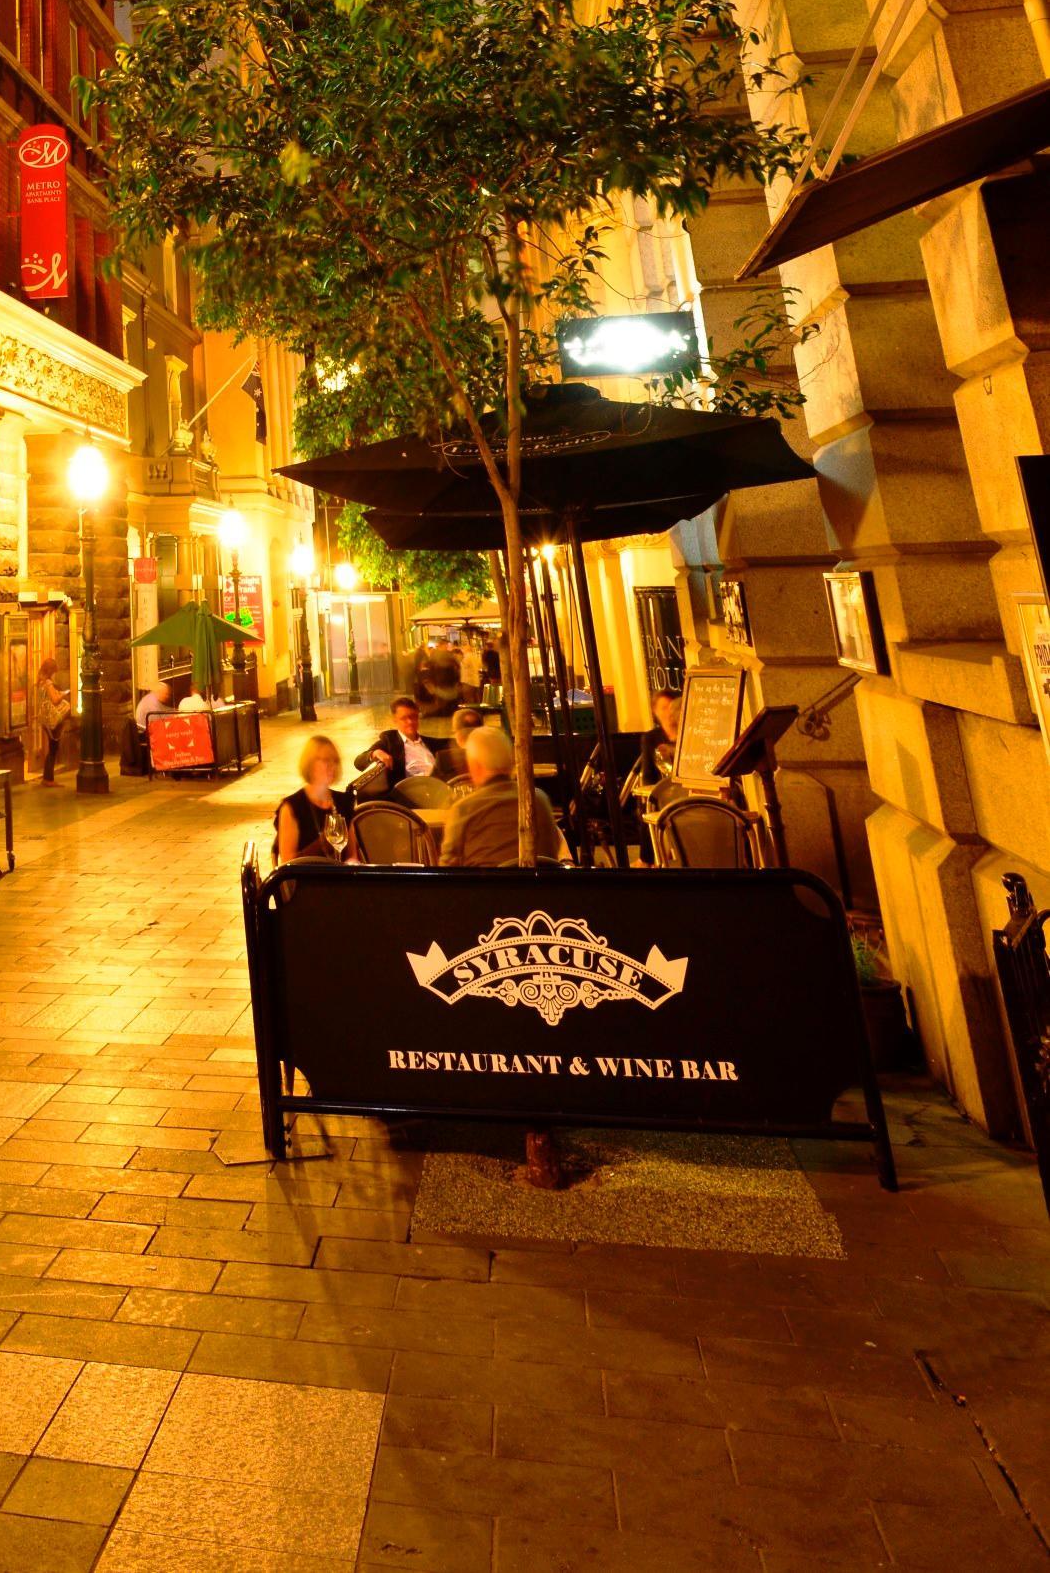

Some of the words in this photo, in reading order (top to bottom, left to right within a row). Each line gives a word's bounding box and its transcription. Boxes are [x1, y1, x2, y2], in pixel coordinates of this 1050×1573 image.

[25, 189, 62, 197] APARTMENTS
[27, 181, 61, 190] METRO
[646, 634, 683, 659] BAN
[453, 944, 644, 991] SYRACUSE
[387, 1049, 562, 1075] RESTAURANT
[569, 1057, 590, 1076] &
[595, 1057, 675, 1079] WINE
[681, 1060, 739, 1081] BAR
